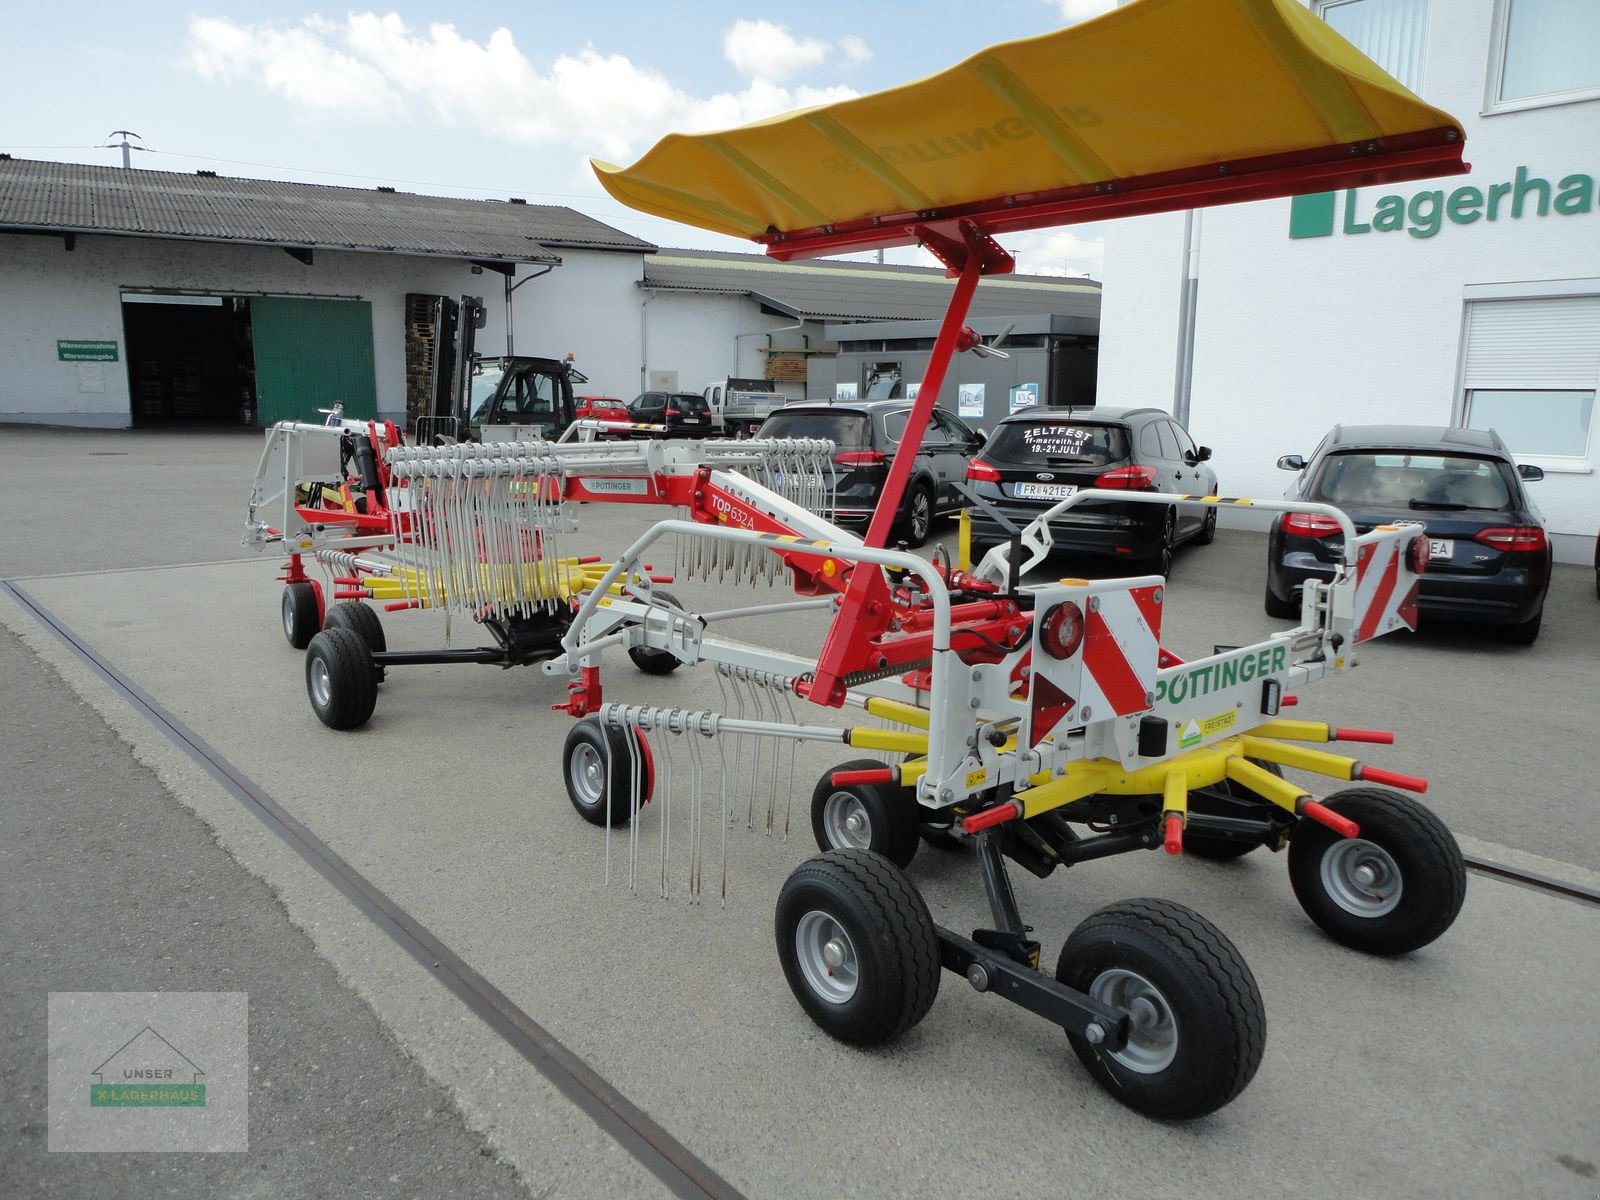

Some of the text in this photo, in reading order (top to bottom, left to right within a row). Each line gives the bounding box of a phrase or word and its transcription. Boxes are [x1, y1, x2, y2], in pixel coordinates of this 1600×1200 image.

[1343, 165, 1600, 238] Lagerha
[1024, 427, 1092, 441] ZELTFEST
[1025, 438, 1084, 446] ff-marreith.at
[1024, 485, 1073, 496] FR 421EZ
[712, 494, 754, 531] TOP 632A
[1430, 543, 1447, 555] EA
[1156, 646, 1285, 704] PÖTTINGER
[1205, 715, 1235, 731] FREISTADT
